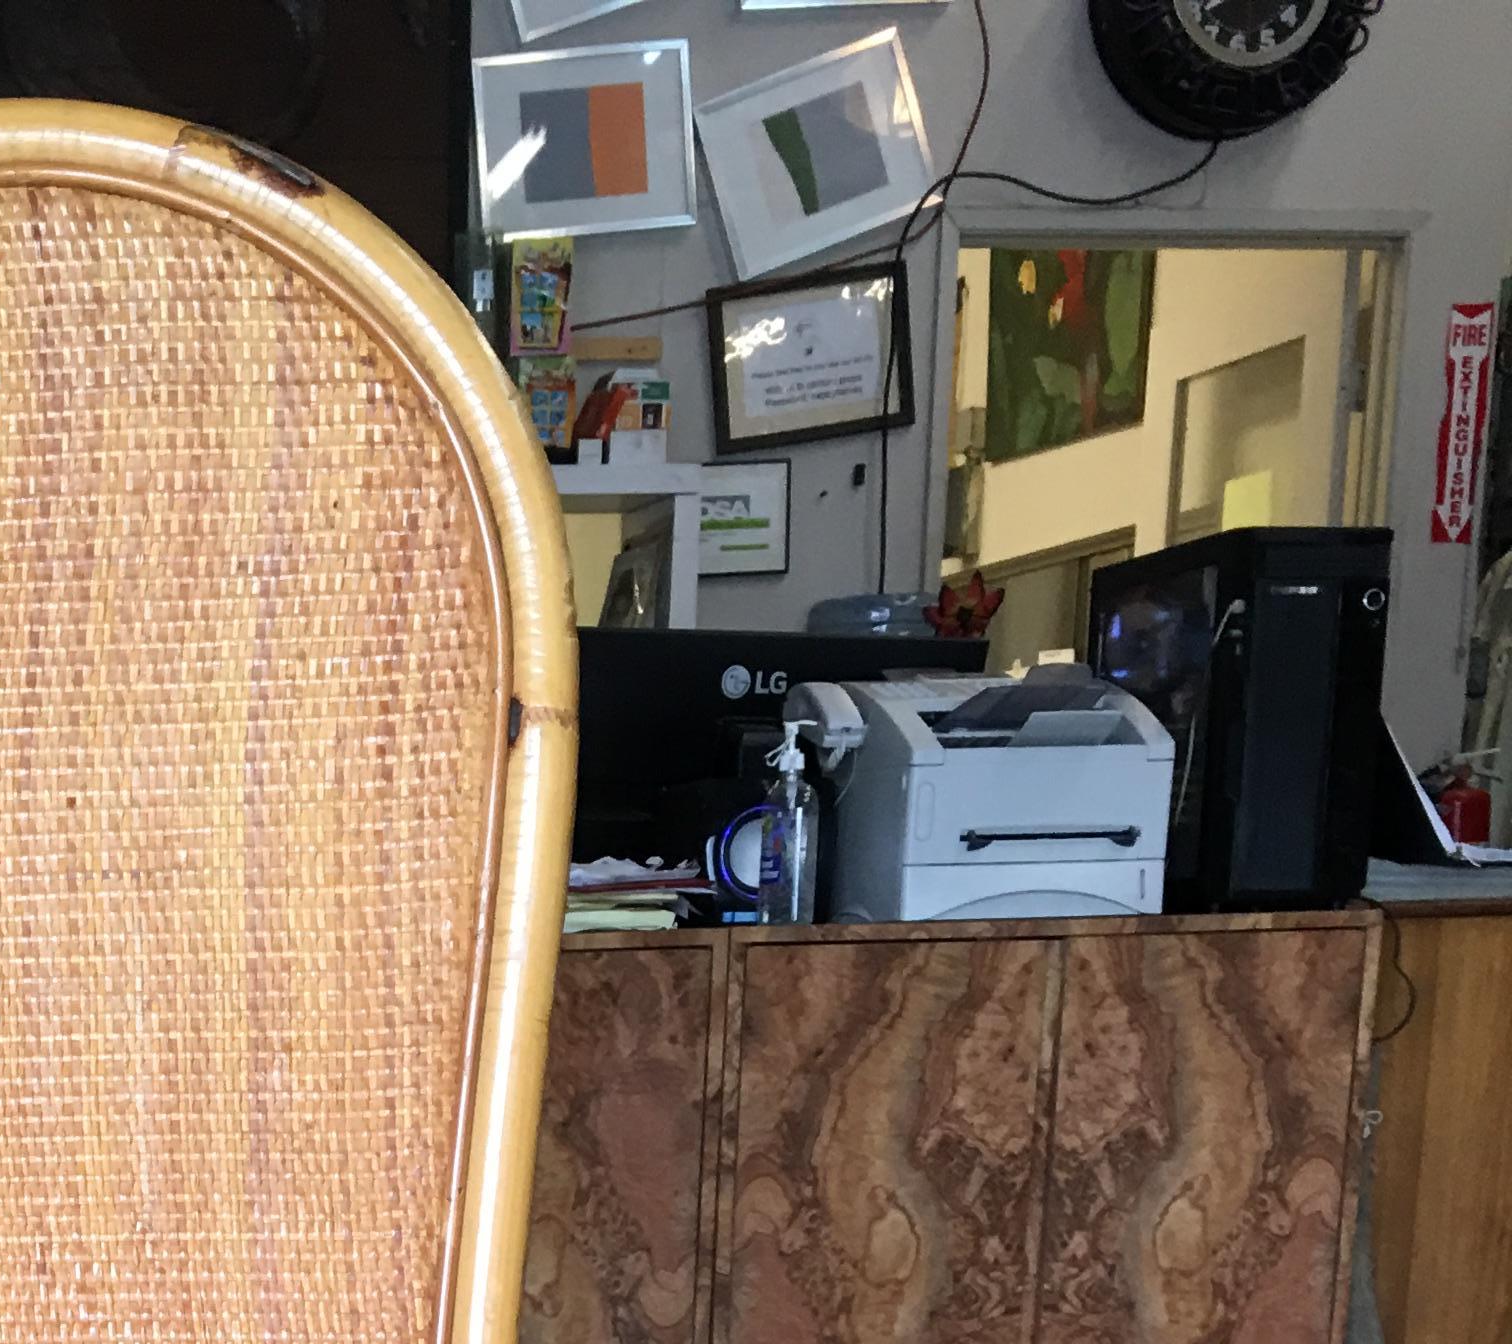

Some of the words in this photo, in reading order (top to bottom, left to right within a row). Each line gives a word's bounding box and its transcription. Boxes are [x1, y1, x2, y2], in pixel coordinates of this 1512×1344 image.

[1259, 27, 1276, 49] 5
[1452, 323, 1487, 348] FIRE
[1448, 355, 1474, 528] EXTINGUISHER
[754, 670, 788, 695] LG
